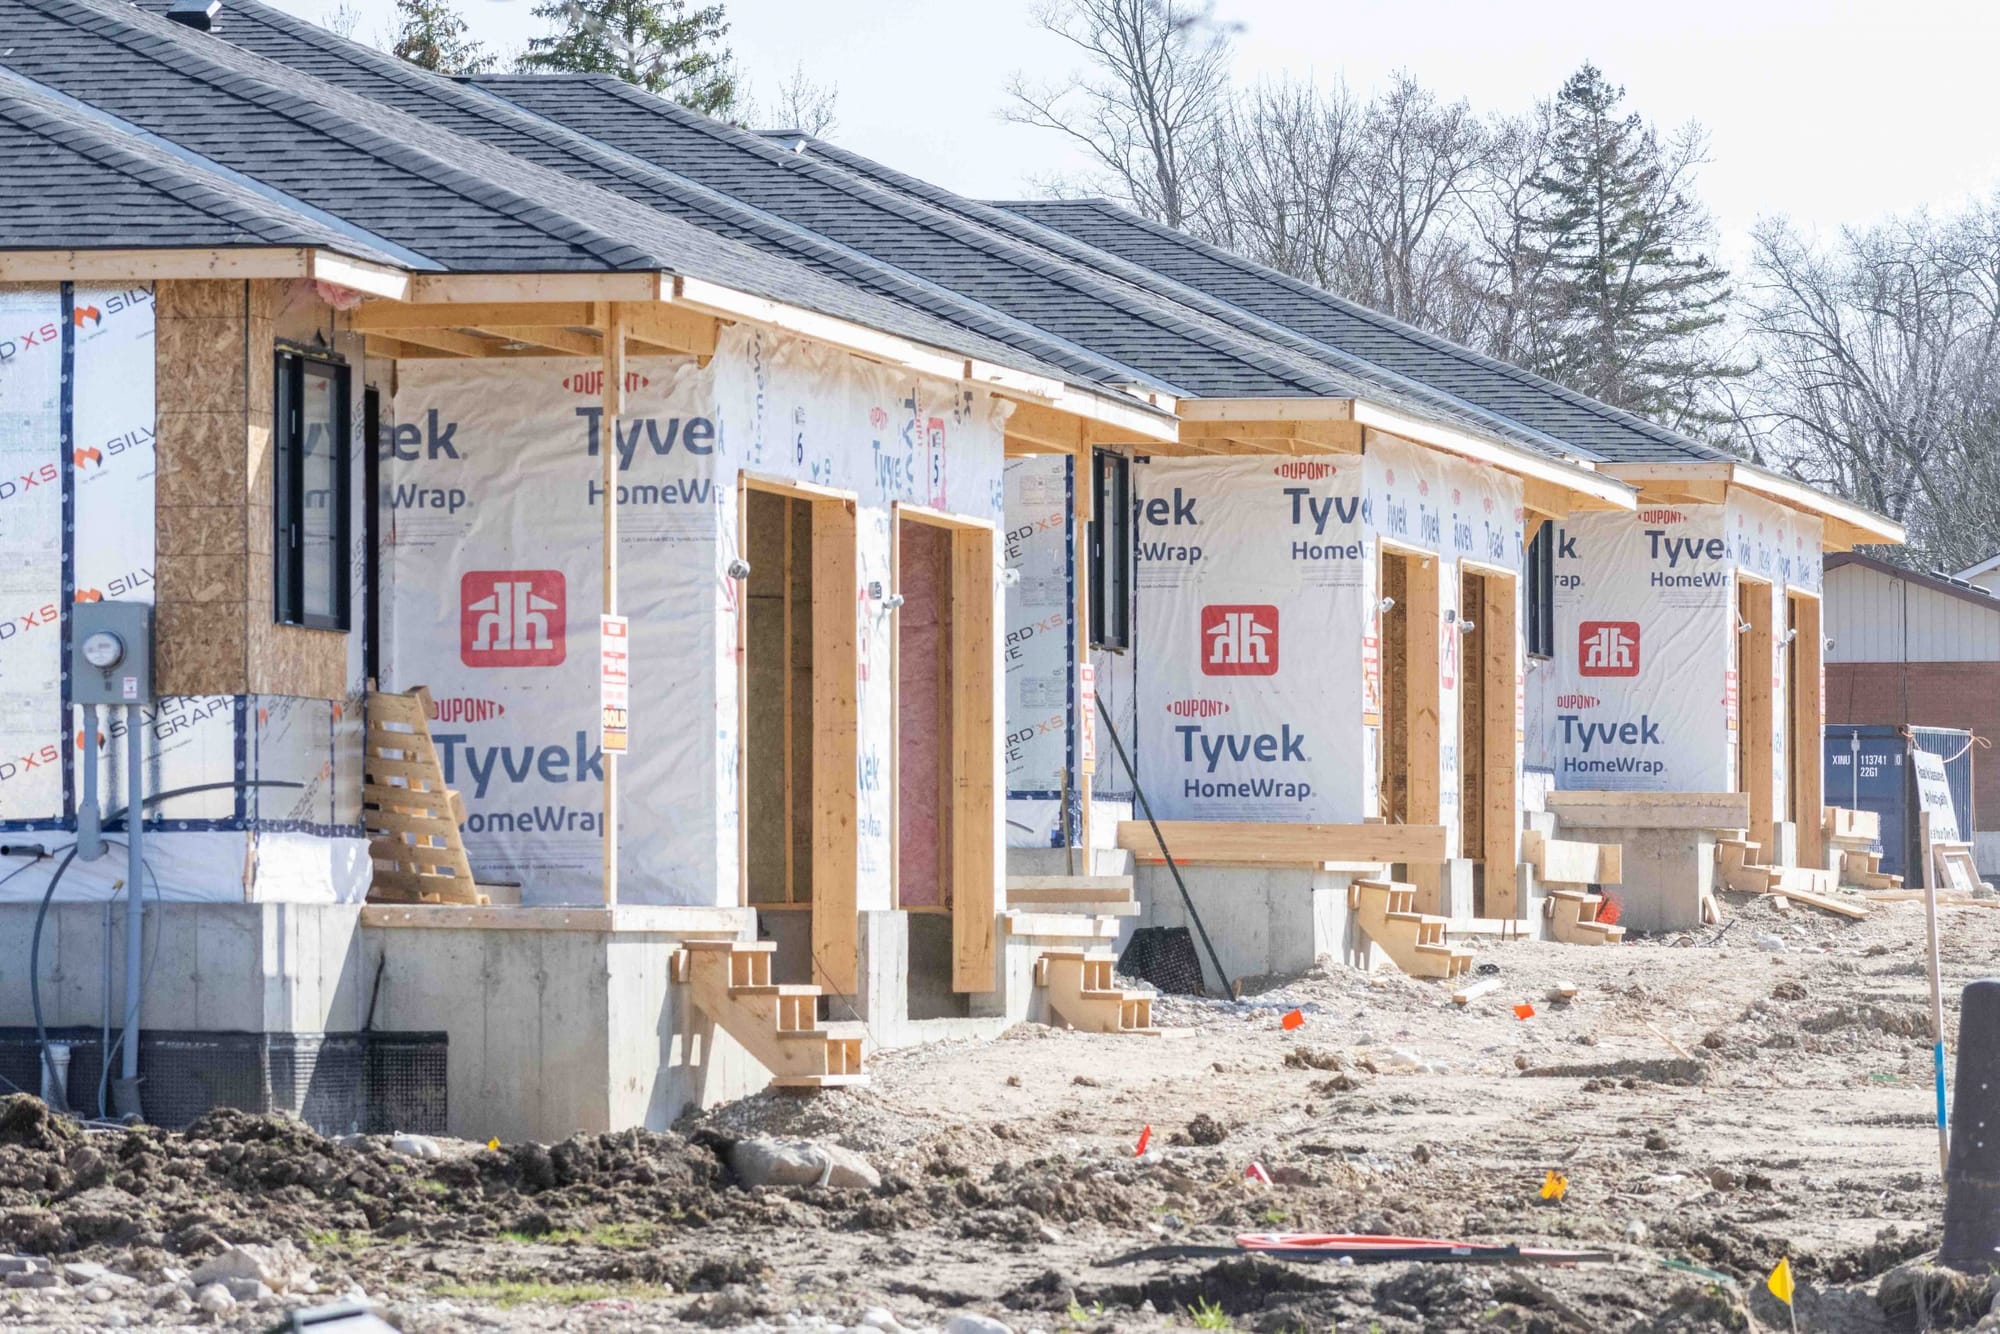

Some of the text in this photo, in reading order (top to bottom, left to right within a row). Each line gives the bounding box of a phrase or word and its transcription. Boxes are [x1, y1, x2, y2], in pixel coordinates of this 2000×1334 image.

[20, 323, 58, 351] XS
[20, 464, 58, 491] XS
[1282, 462, 1330, 480] DUPONT
[1643, 510, 1682, 525] DUPONT
[20, 604, 58, 632] XS
[1174, 699, 1223, 718] DUPONT
[1557, 694, 1595, 710] DUPONT
[1558, 715, 1660, 752] Tyvek
[21, 744, 58, 772] XS
[1175, 724, 1306, 773] Tyvek
[1563, 757, 1664, 776] HomeWrap
[1860, 755, 1887, 765] 113741
[1860, 767, 1878, 777] 22G1
[1184, 778, 1311, 802] HomeWrap
